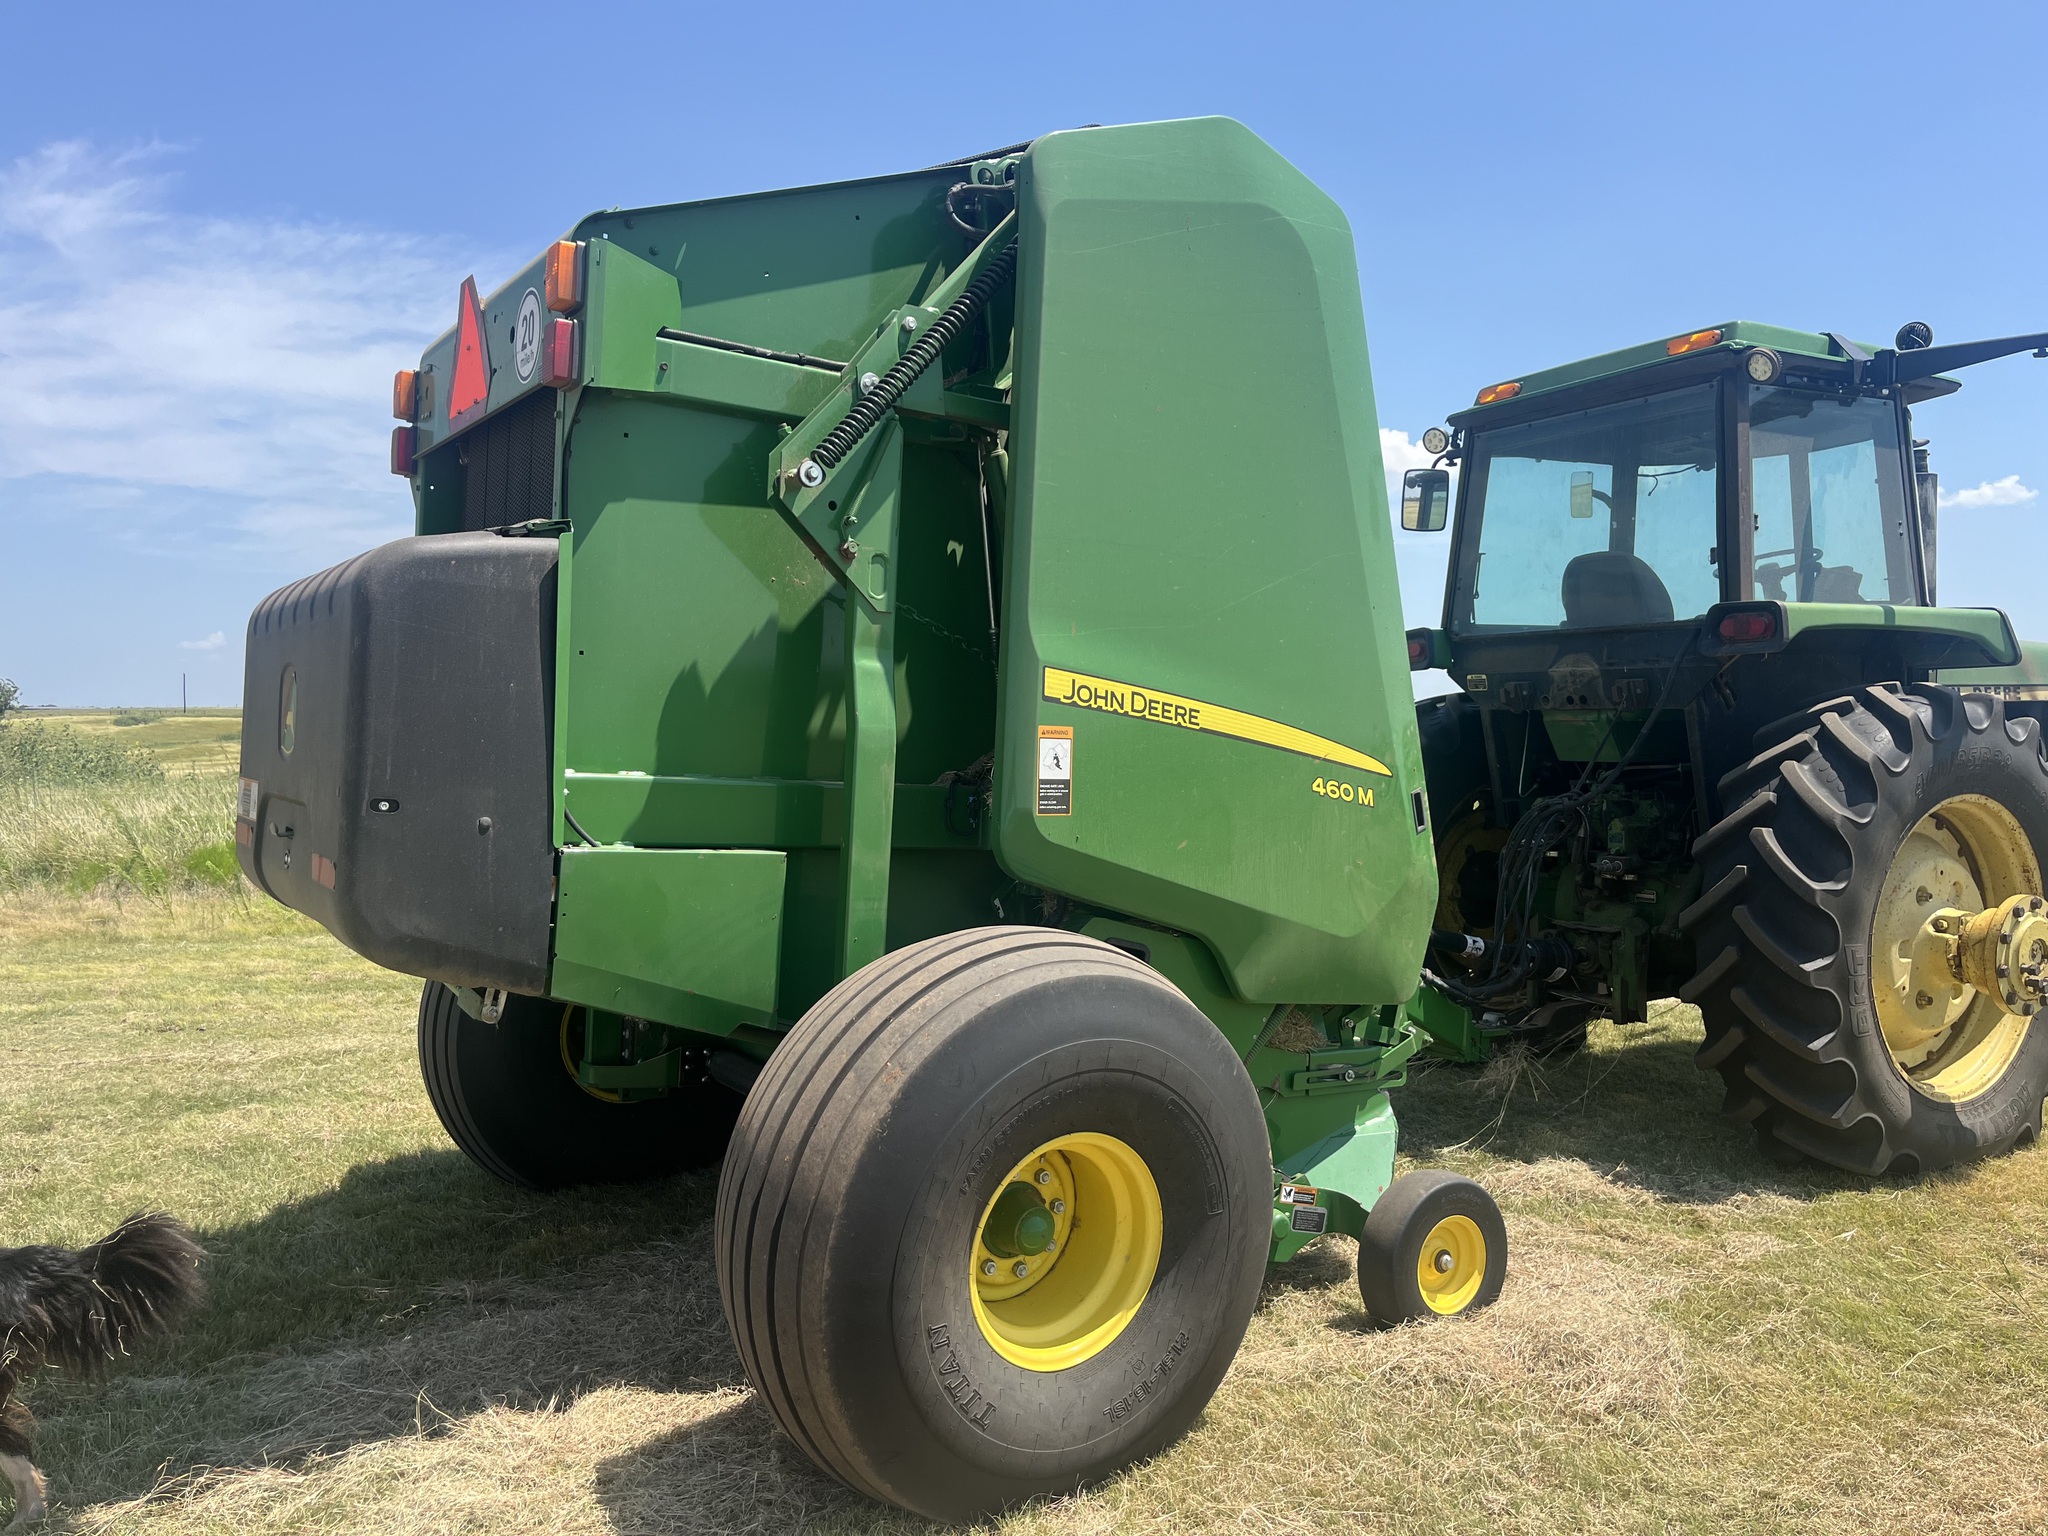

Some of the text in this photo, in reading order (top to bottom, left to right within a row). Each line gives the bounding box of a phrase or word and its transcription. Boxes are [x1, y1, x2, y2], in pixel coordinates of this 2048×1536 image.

[520, 309, 535, 352] 20
[1063, 678, 1201, 727] JOHN DEERE
[1311, 776, 1375, 808] 460 M
[1844, 943, 1872, 1037] BKT
[960, 1146, 993, 1197] FARM
[928, 1322, 997, 1432] TITAN
